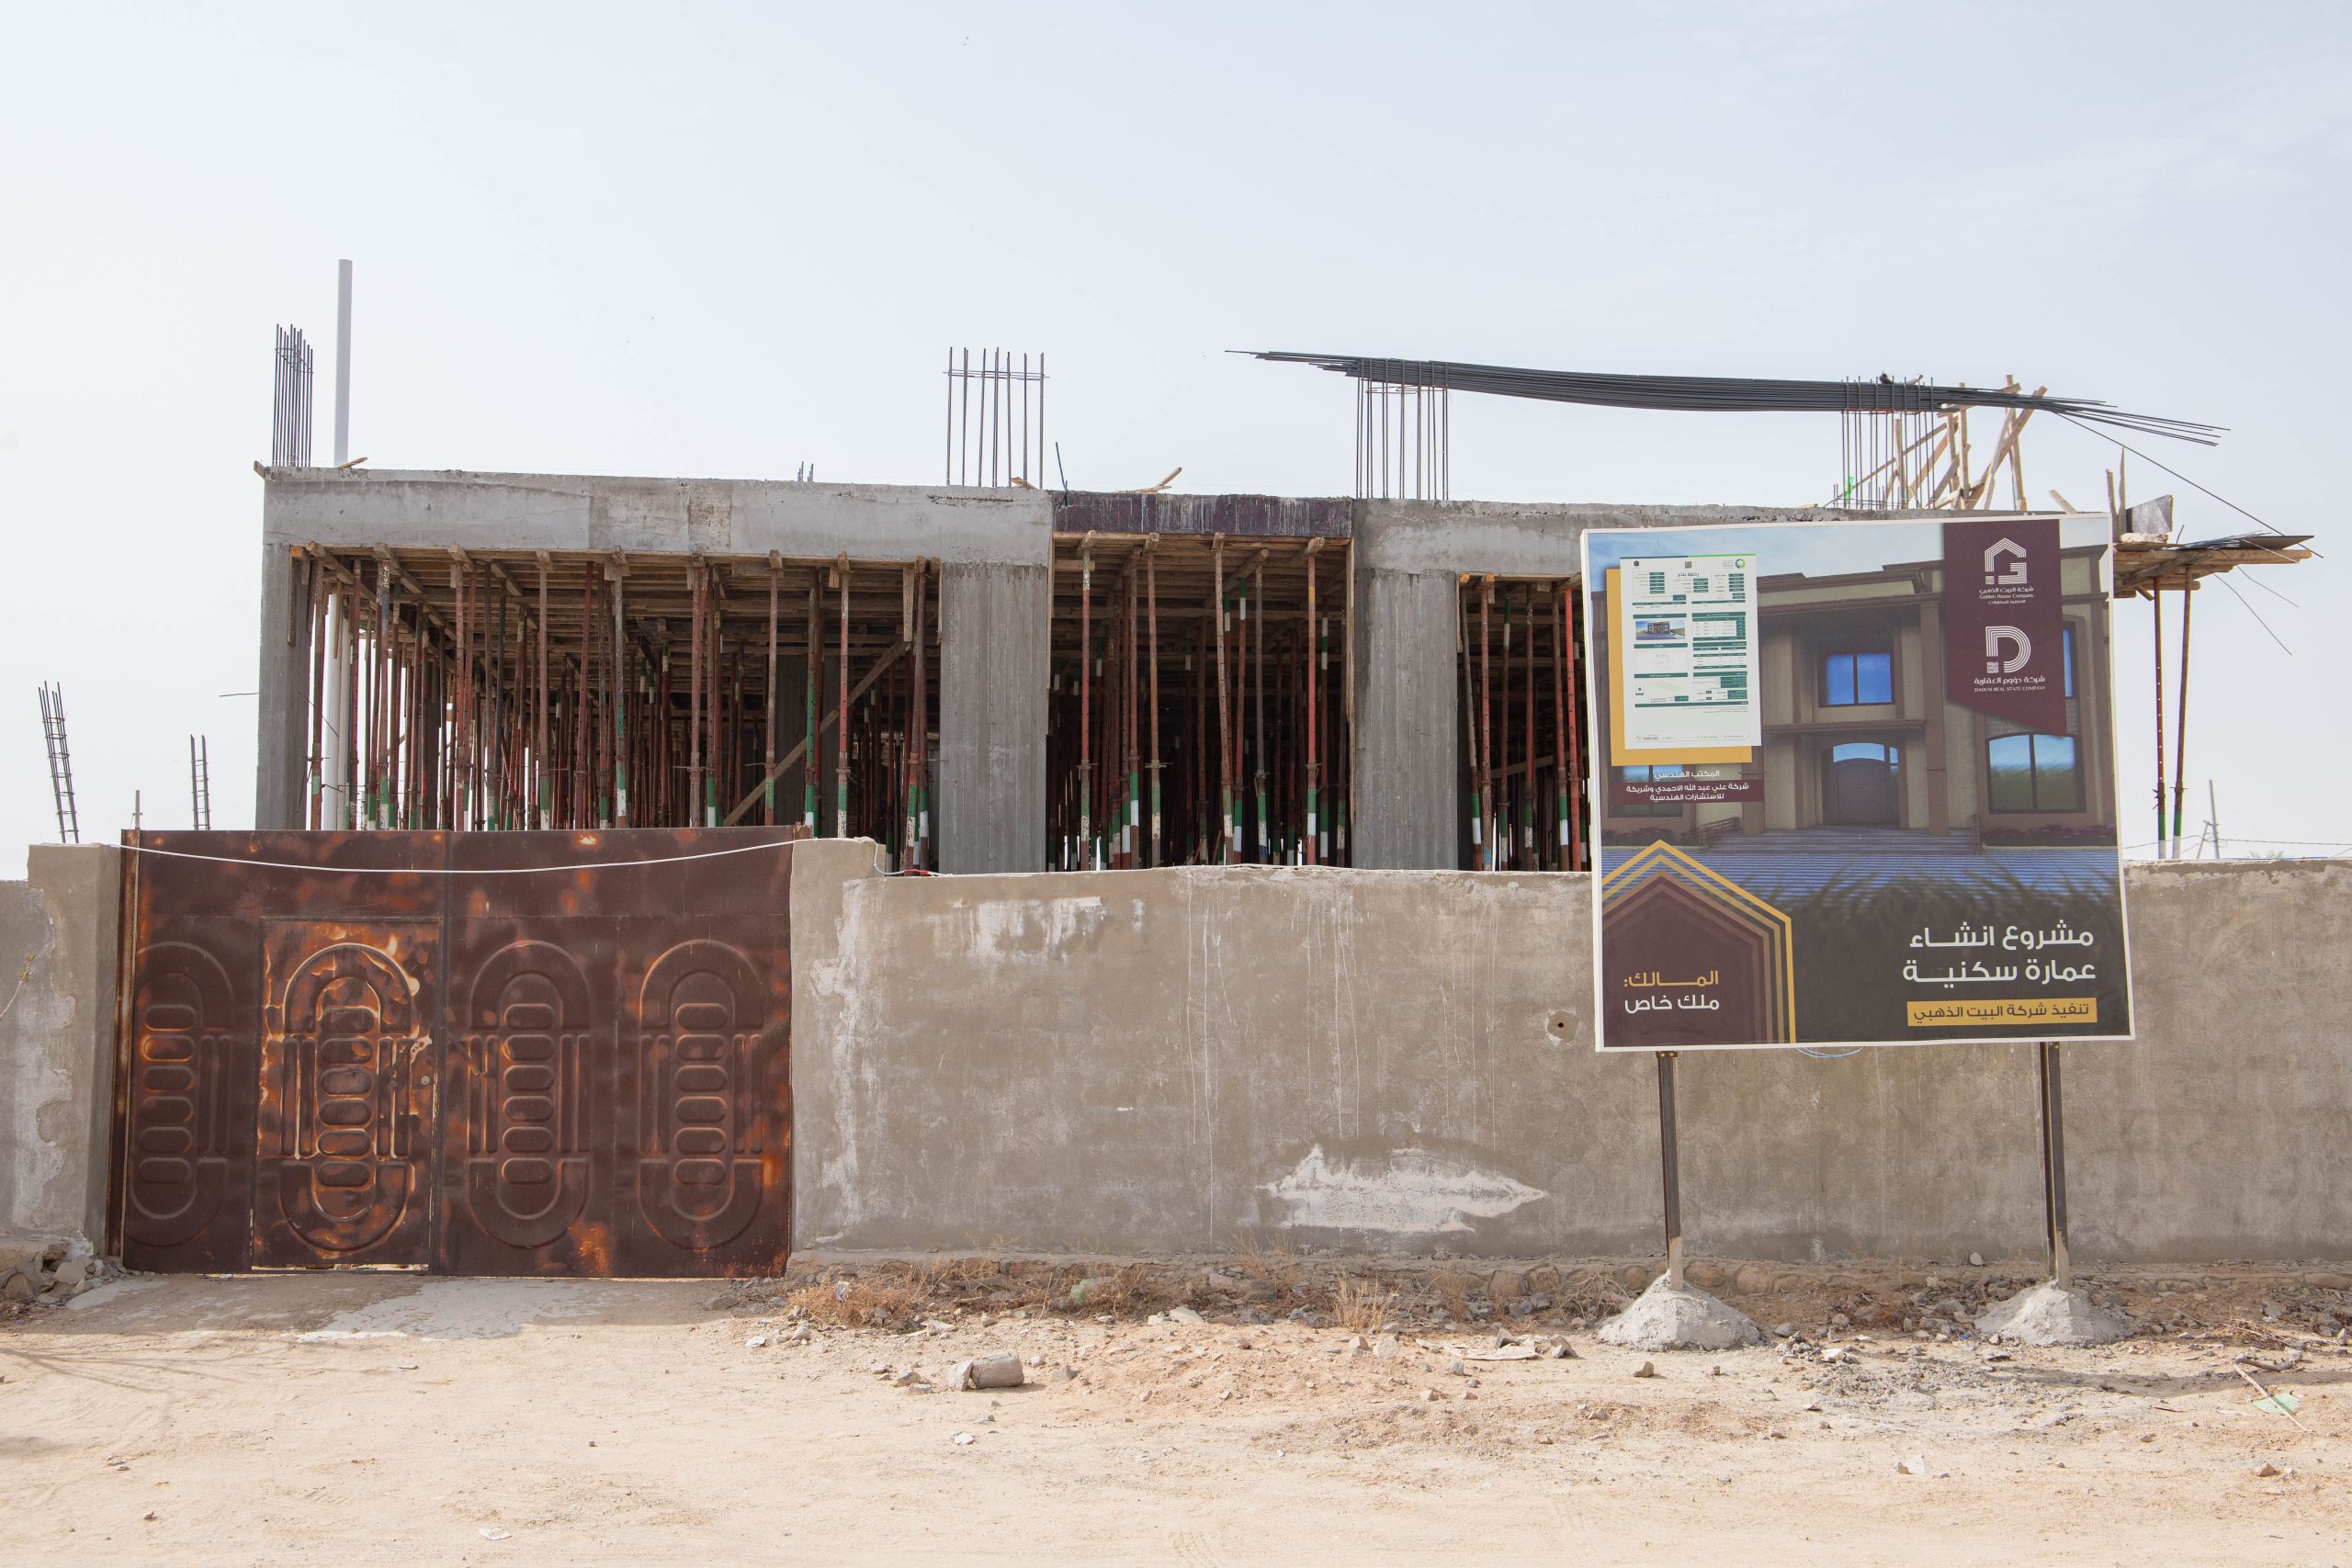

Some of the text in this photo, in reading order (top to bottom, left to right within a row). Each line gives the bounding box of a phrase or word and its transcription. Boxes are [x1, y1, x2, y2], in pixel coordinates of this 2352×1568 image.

[2023, 674, 2045, 683] شركة
[1654, 770, 1720, 781] المكتب الهندسي
[1655, 784, 1683, 793] الاحمدي
[1712, 784, 1726, 793] علي
[1727, 782, 1749, 790] شركة
[1685, 793, 1724, 801] للاستشارات
[2002, 919, 2094, 951] مشروع
[2025, 958, 2096, 985] عمارة
[1624, 994, 1720, 1014] ملك خاص
[1913, 1002, 2090, 1024] تنفيذ شركة البيت الذهبي
